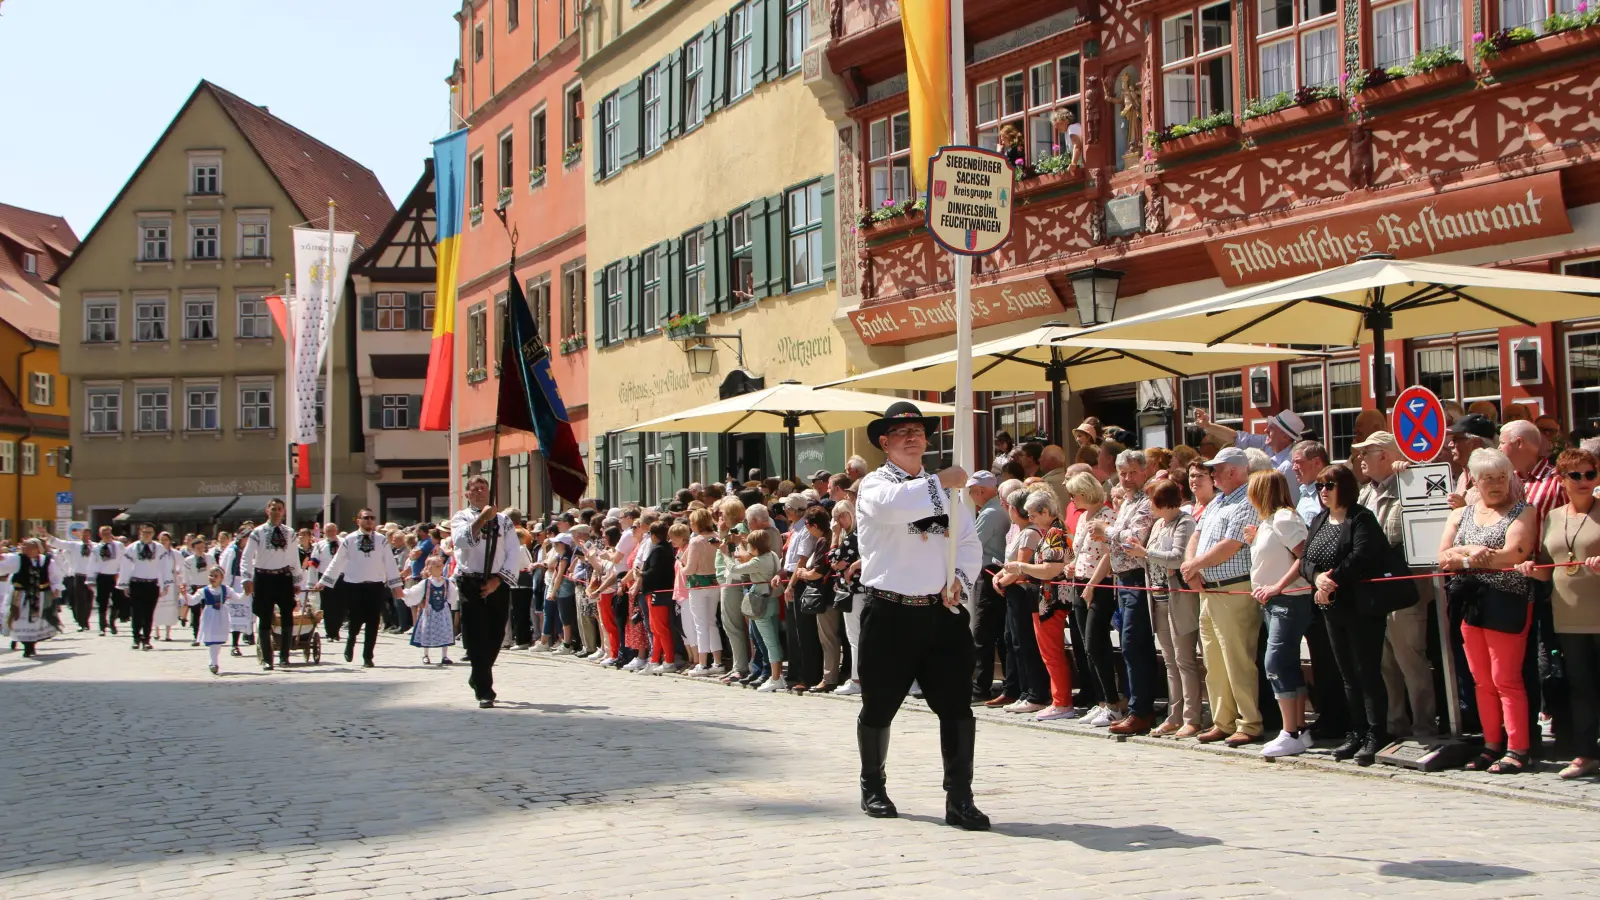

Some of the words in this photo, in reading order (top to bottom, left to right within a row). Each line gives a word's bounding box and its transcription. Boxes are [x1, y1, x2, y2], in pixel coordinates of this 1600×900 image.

[946, 155, 1002, 174] SIEBENBÜRGER
[956, 171, 990, 187] SACHSEN
[953, 185, 993, 200] Kreisgruppe
[947, 201, 998, 219] DINKELSBÜHL
[940, 214, 1001, 233] FEUCHTWANGEN
[1376, 188, 1543, 253] Restaurant
[856, 311, 900, 339] Hotel
[1001, 284, 1052, 314] Haus
[777, 328, 833, 367] Metzgerei
